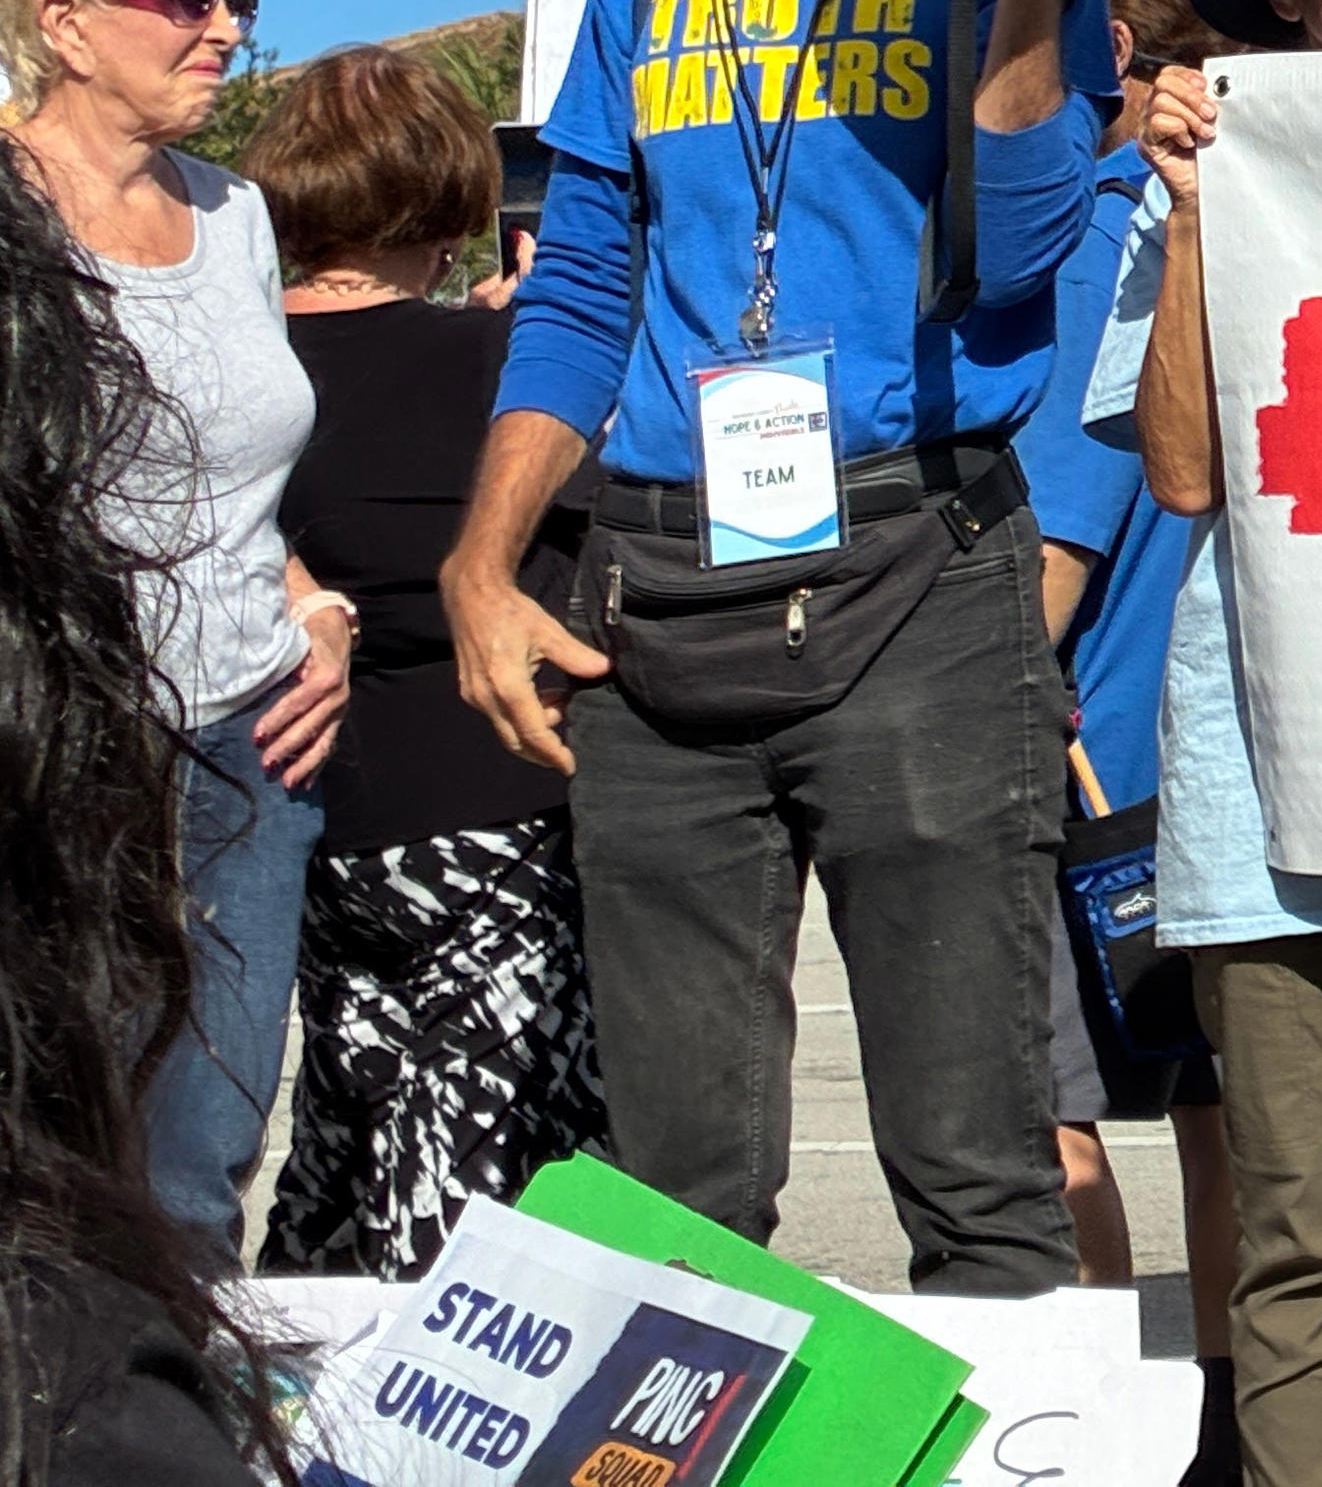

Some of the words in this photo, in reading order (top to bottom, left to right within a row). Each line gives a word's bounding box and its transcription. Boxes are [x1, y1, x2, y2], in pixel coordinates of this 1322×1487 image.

[632, 39, 932, 140] MATTERS
[765, 413, 805, 429] ACTION
[743, 465, 795, 489] TEAM
[423, 1282, 572, 1379] STAND
[375, 1361, 531, 1470] UNITED
